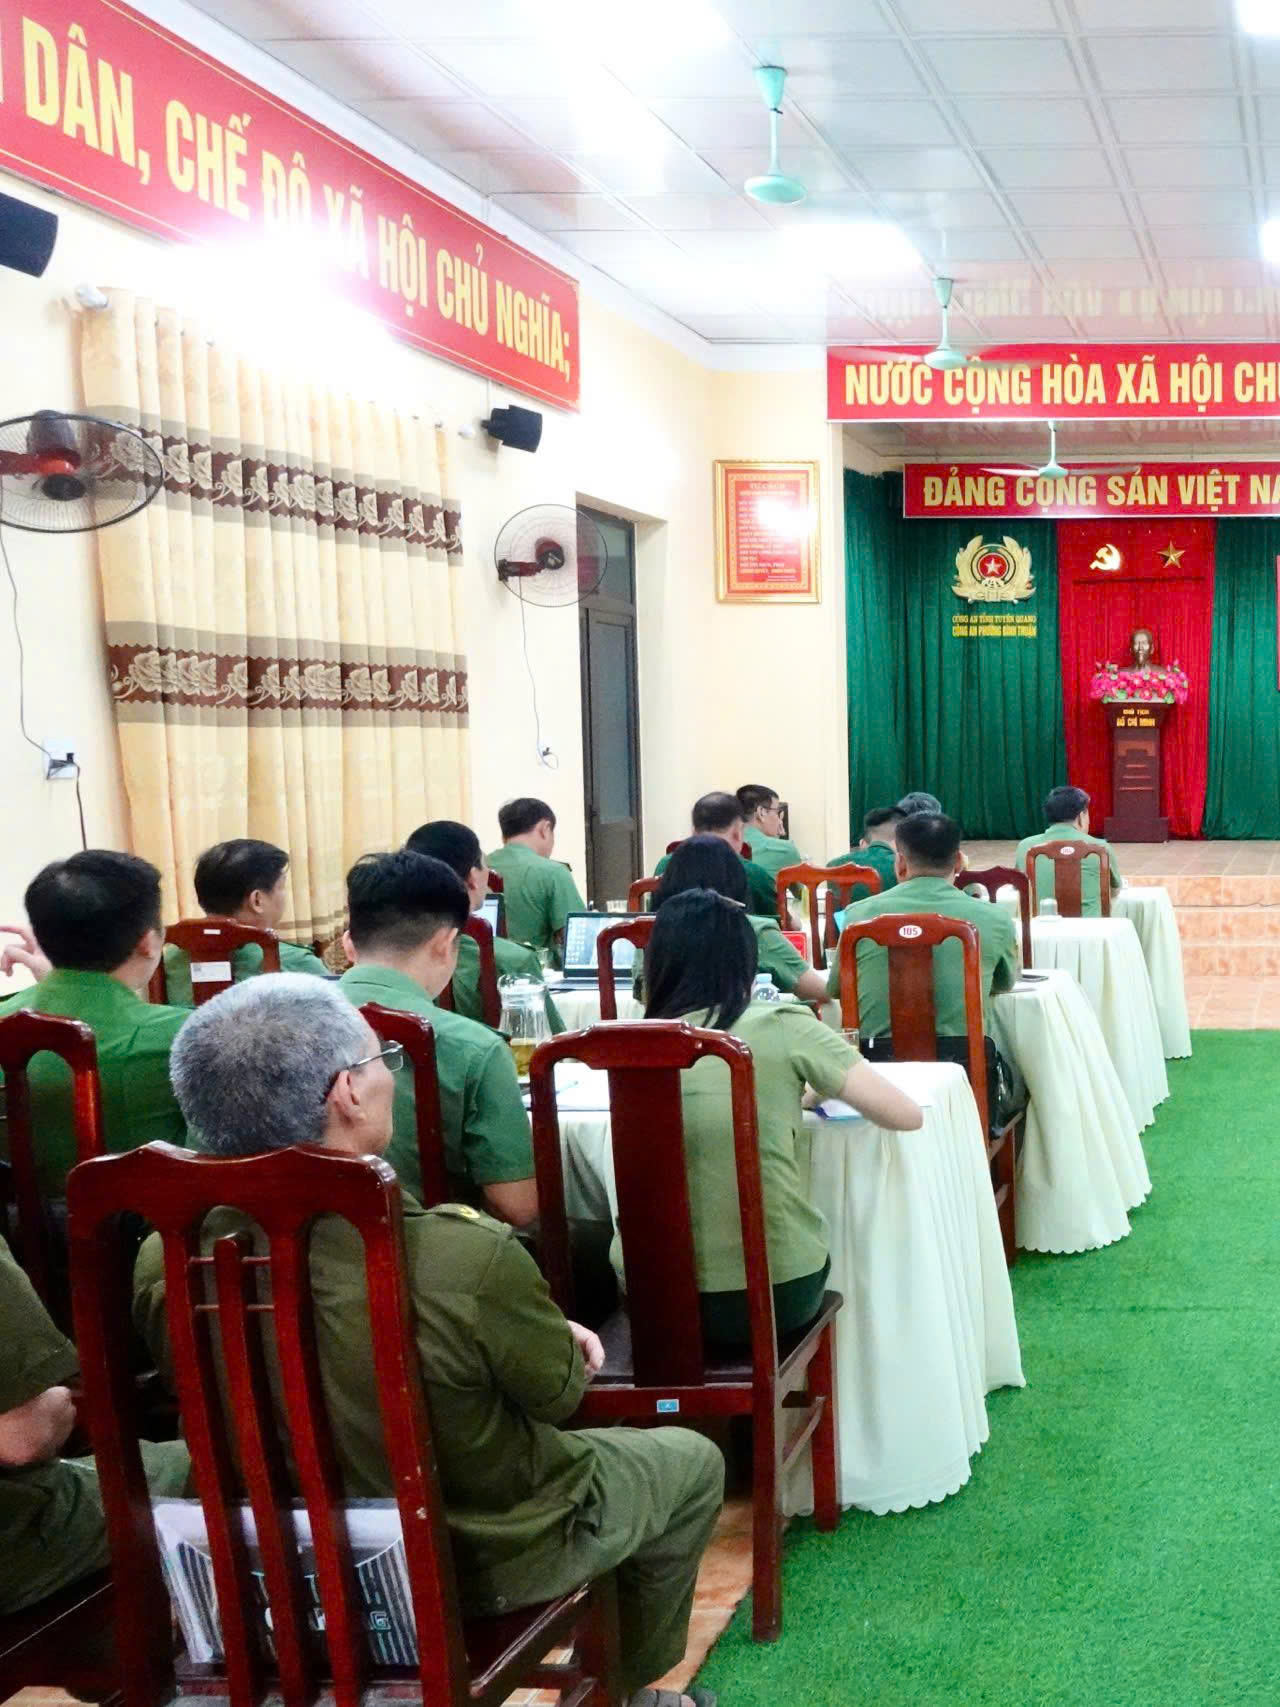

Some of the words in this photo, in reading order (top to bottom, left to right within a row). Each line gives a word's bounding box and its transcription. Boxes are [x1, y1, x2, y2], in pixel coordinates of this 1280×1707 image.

[22, 16, 151, 185] DÂN,
[165, 99, 252, 221] CHẾ
[378, 213, 428, 317] HỘI
[436, 242, 489, 336] CHỦ
[495, 280, 570, 383] NGHĨA;
[1042, 353, 1106, 405] HÒA
[1117, 355, 1160, 404] XÃ
[1170, 355, 1223, 412] HỘI
[923, 466, 1005, 506] ĐẢNG
[1178, 469, 1240, 512] VIỆT
